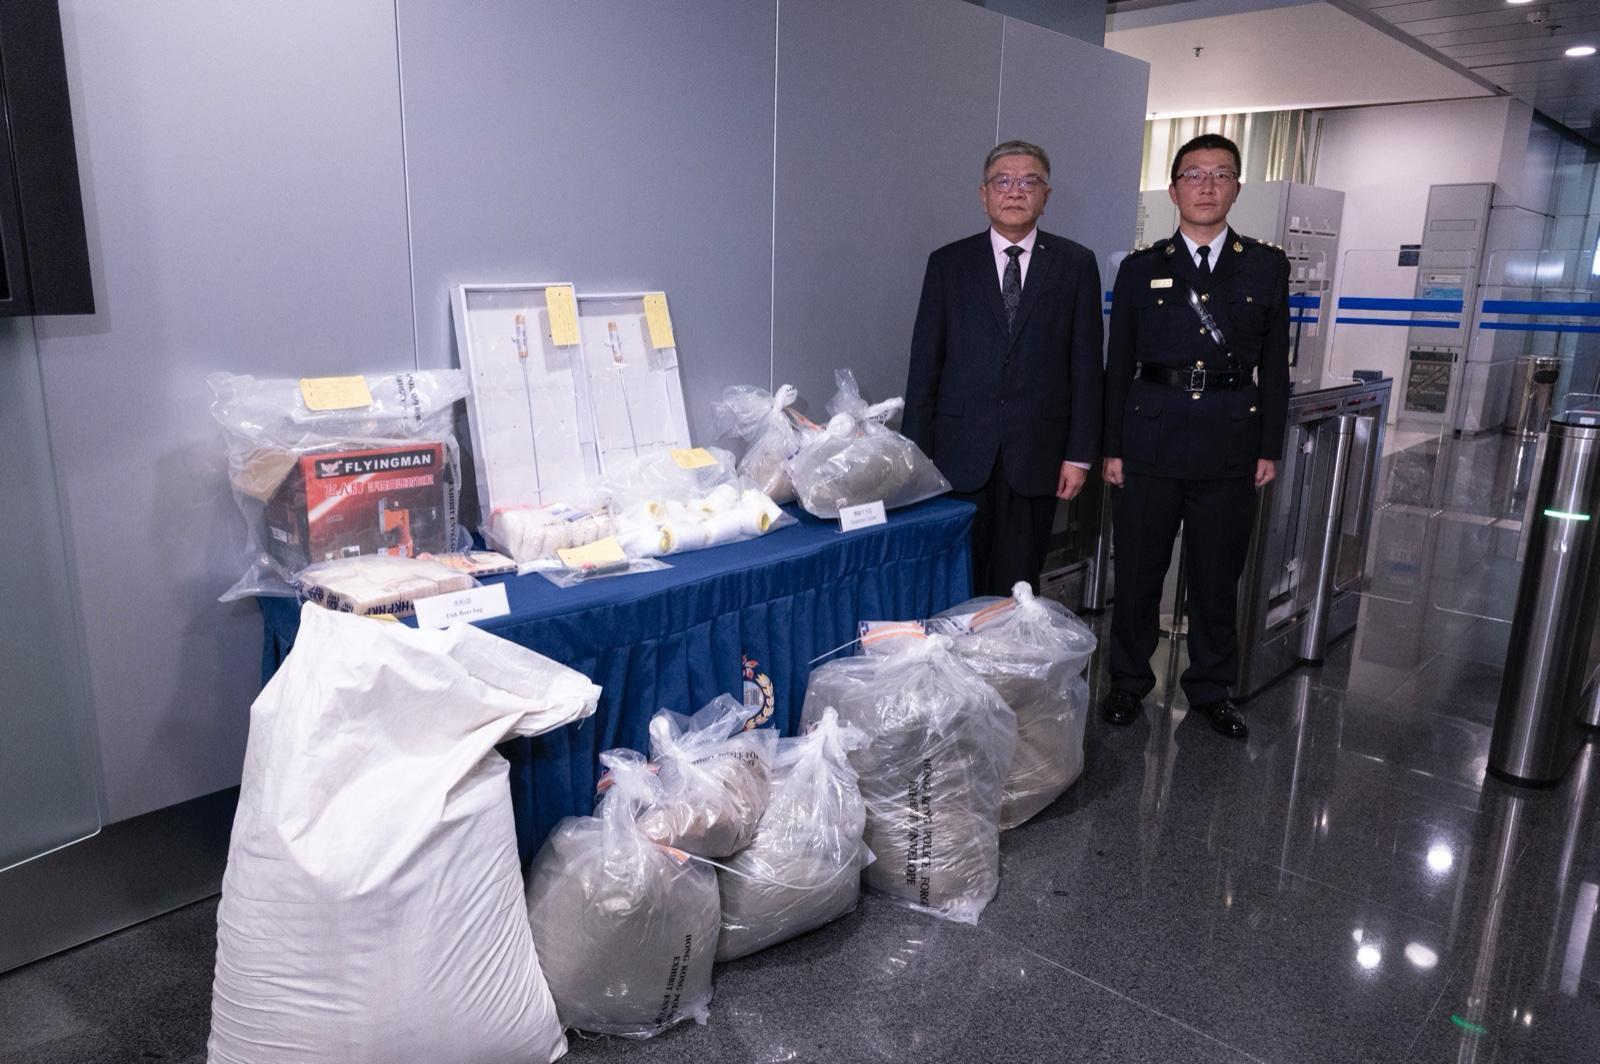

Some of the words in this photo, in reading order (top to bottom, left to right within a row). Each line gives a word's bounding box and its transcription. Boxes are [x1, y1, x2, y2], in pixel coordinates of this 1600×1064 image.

[345, 454, 431, 473] FLYINGMAN
[922, 758, 932, 789] HONG
[921, 795, 933, 824] KONG
[906, 827, 918, 886] ENVELOPE
[921, 831, 932, 868] POLICE
[683, 934, 692, 962] HONG
[666, 956, 680, 991] EXHIBIT
[676, 965, 689, 991] KONG
